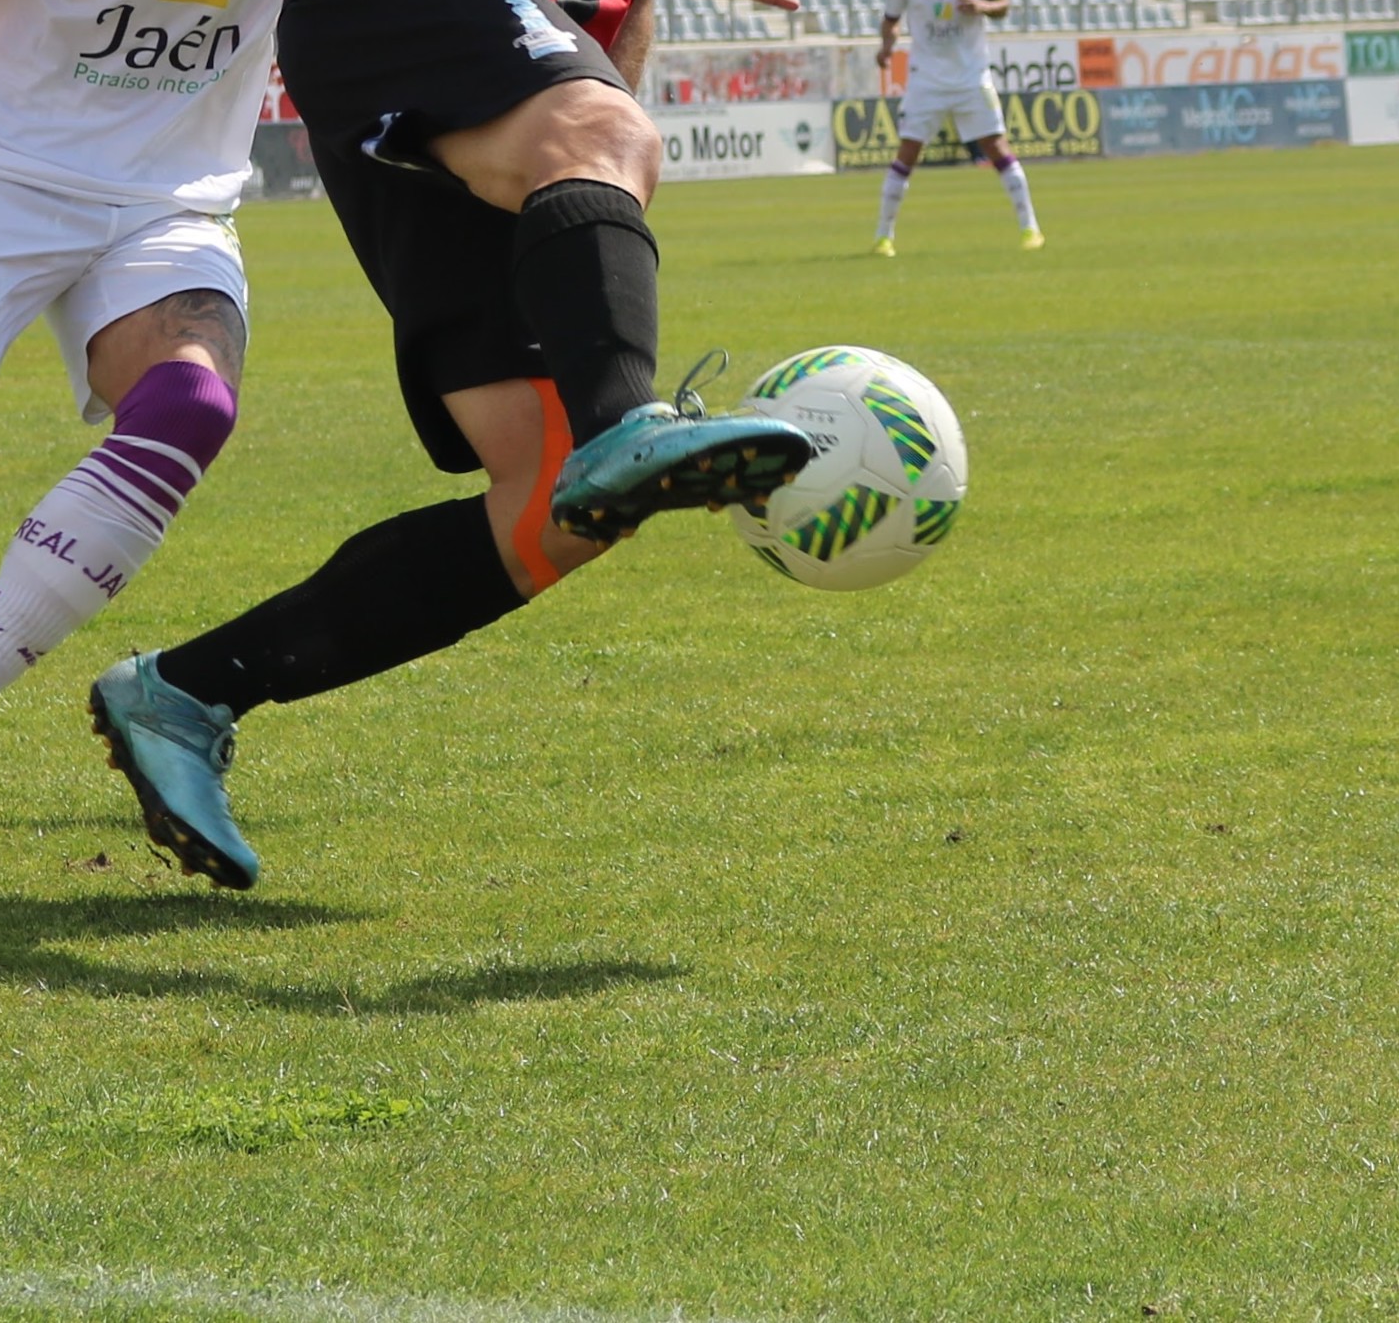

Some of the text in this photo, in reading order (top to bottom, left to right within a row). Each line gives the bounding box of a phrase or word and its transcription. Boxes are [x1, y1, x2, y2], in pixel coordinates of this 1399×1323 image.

[80, 4, 240, 72] Jaén
[74, 62, 150, 90] Paraíso
[1004, 89, 1100, 143] ACO
[692, 125, 764, 161] Motor
[13, 517, 77, 565] REAL
